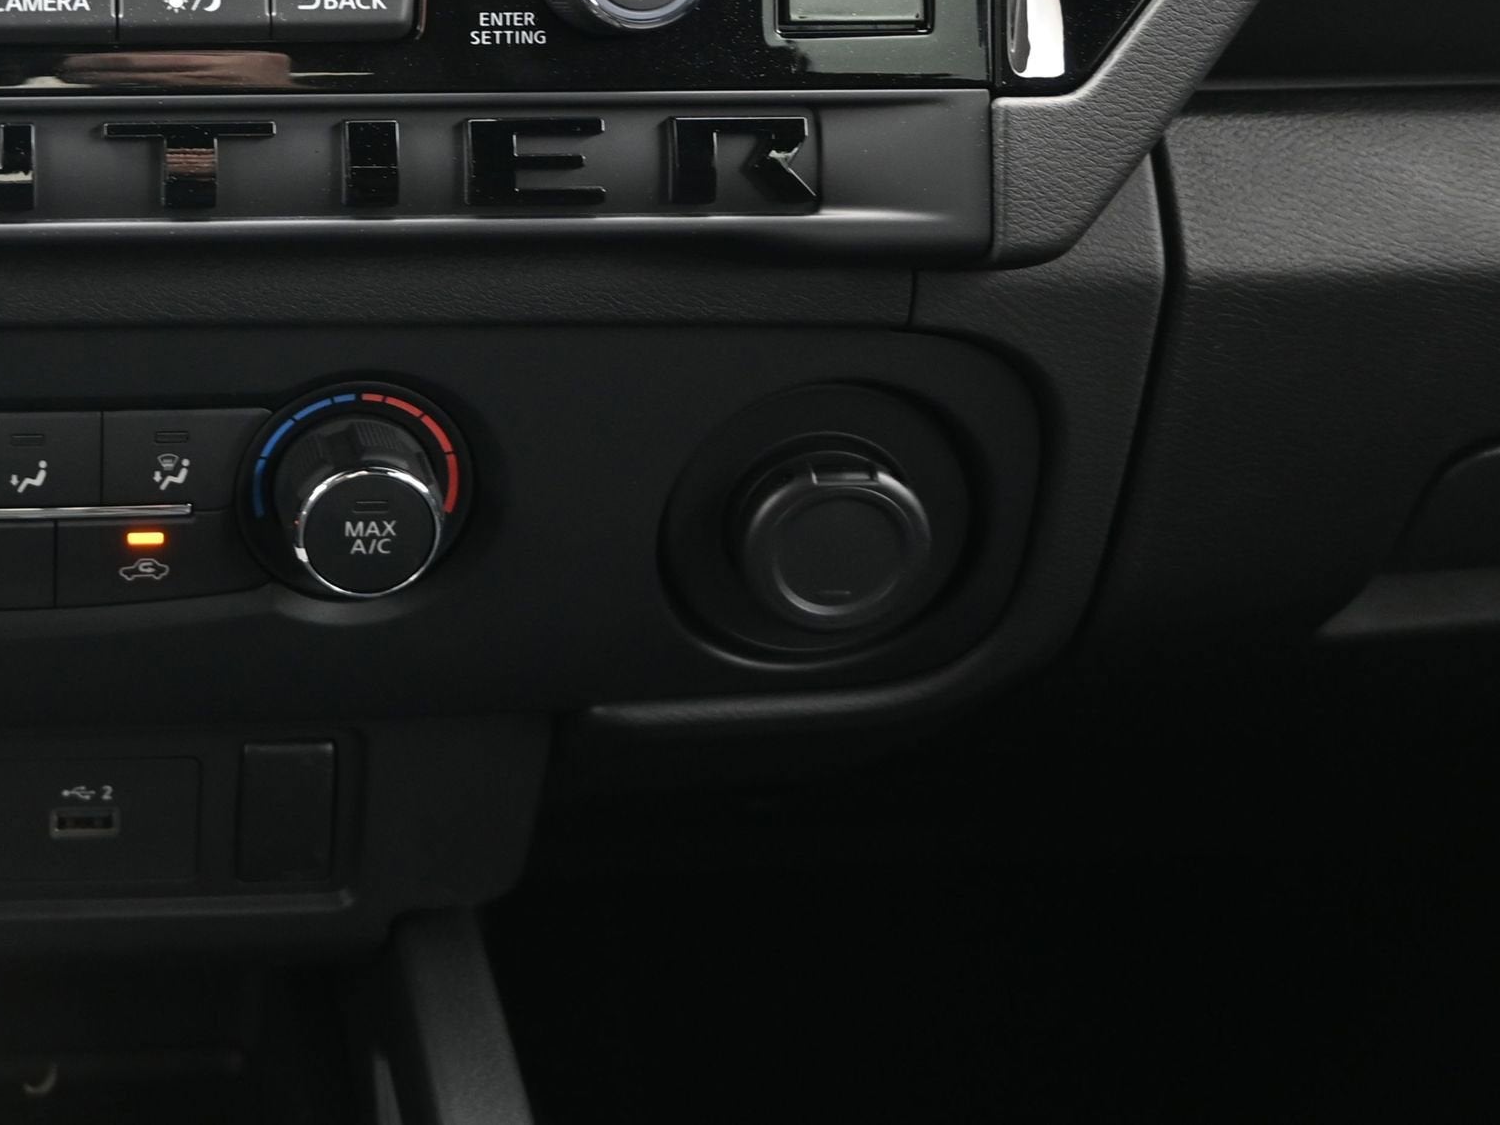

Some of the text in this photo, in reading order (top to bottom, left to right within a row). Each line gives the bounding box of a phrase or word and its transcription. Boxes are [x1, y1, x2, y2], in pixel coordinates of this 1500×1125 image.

[478, 11, 535, 28] ENTER
[469, 28, 547, 45] SETTING
[344, 520, 396, 538] MAX
[349, 538, 391, 555] A/C
[102, 785, 113, 800] 2
